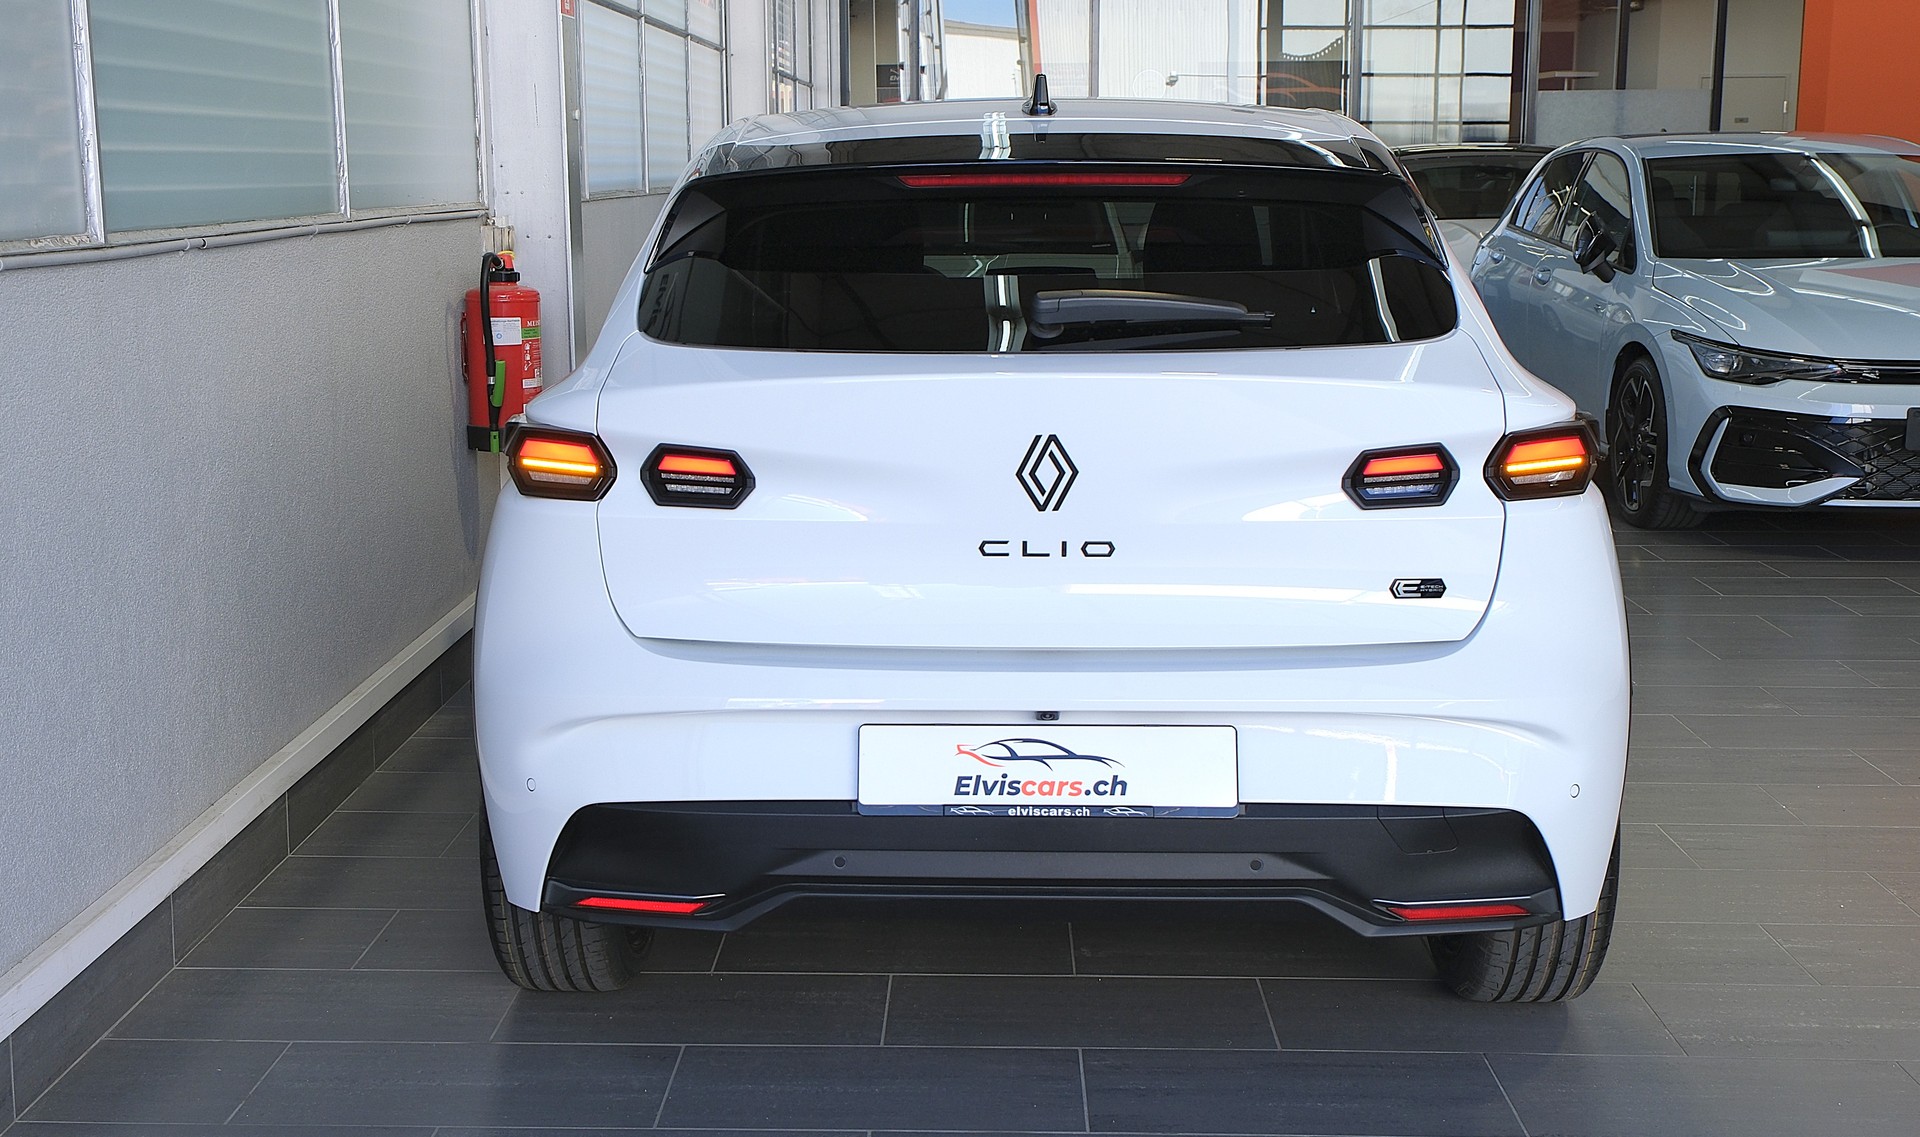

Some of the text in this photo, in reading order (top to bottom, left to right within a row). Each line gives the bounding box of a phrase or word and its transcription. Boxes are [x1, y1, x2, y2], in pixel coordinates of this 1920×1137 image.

[978, 540, 1116, 557] CLIO
[954, 773, 1128, 797] Elviscars.ch
[1007, 806, 1091, 817] elviscars.ch
